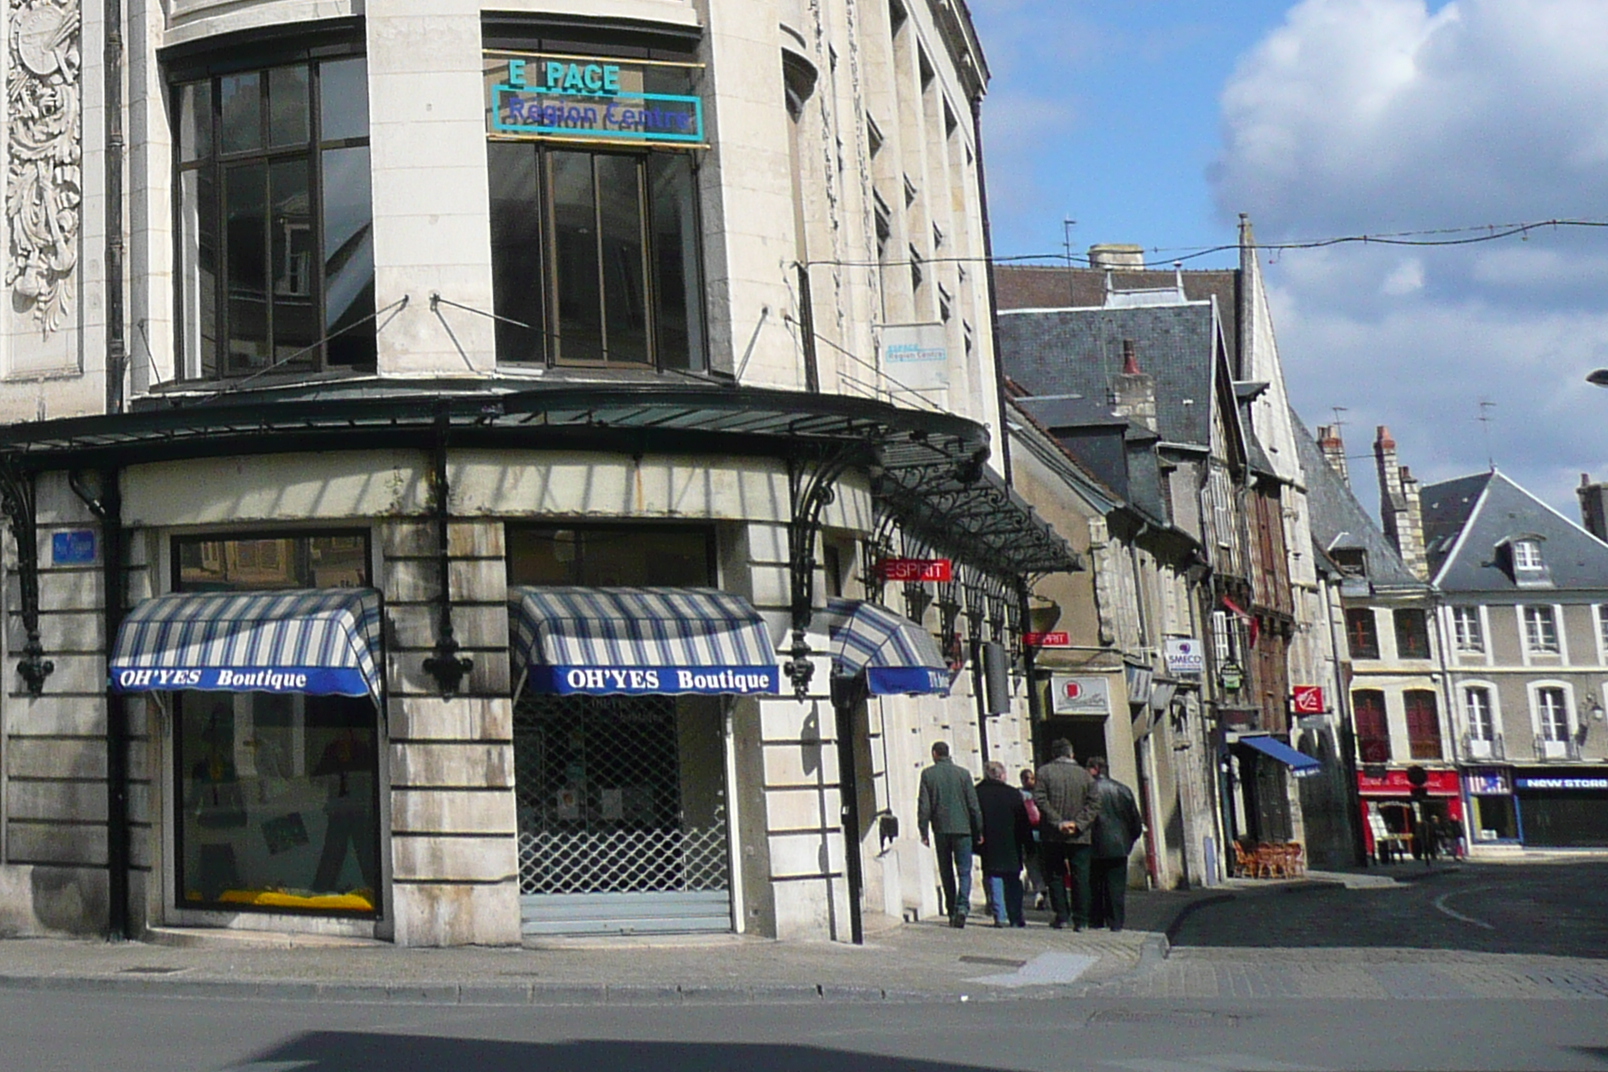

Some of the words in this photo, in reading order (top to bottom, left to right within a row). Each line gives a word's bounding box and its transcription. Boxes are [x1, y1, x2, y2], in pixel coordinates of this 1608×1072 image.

[605, 102, 690, 130] Centre
[886, 562, 945, 578] ESPRIT
[119, 669, 202, 687] OH'YES
[216, 669, 307, 690] Boutique
[566, 669, 660, 689] OH'YES
[676, 670, 770, 693] Boutique
